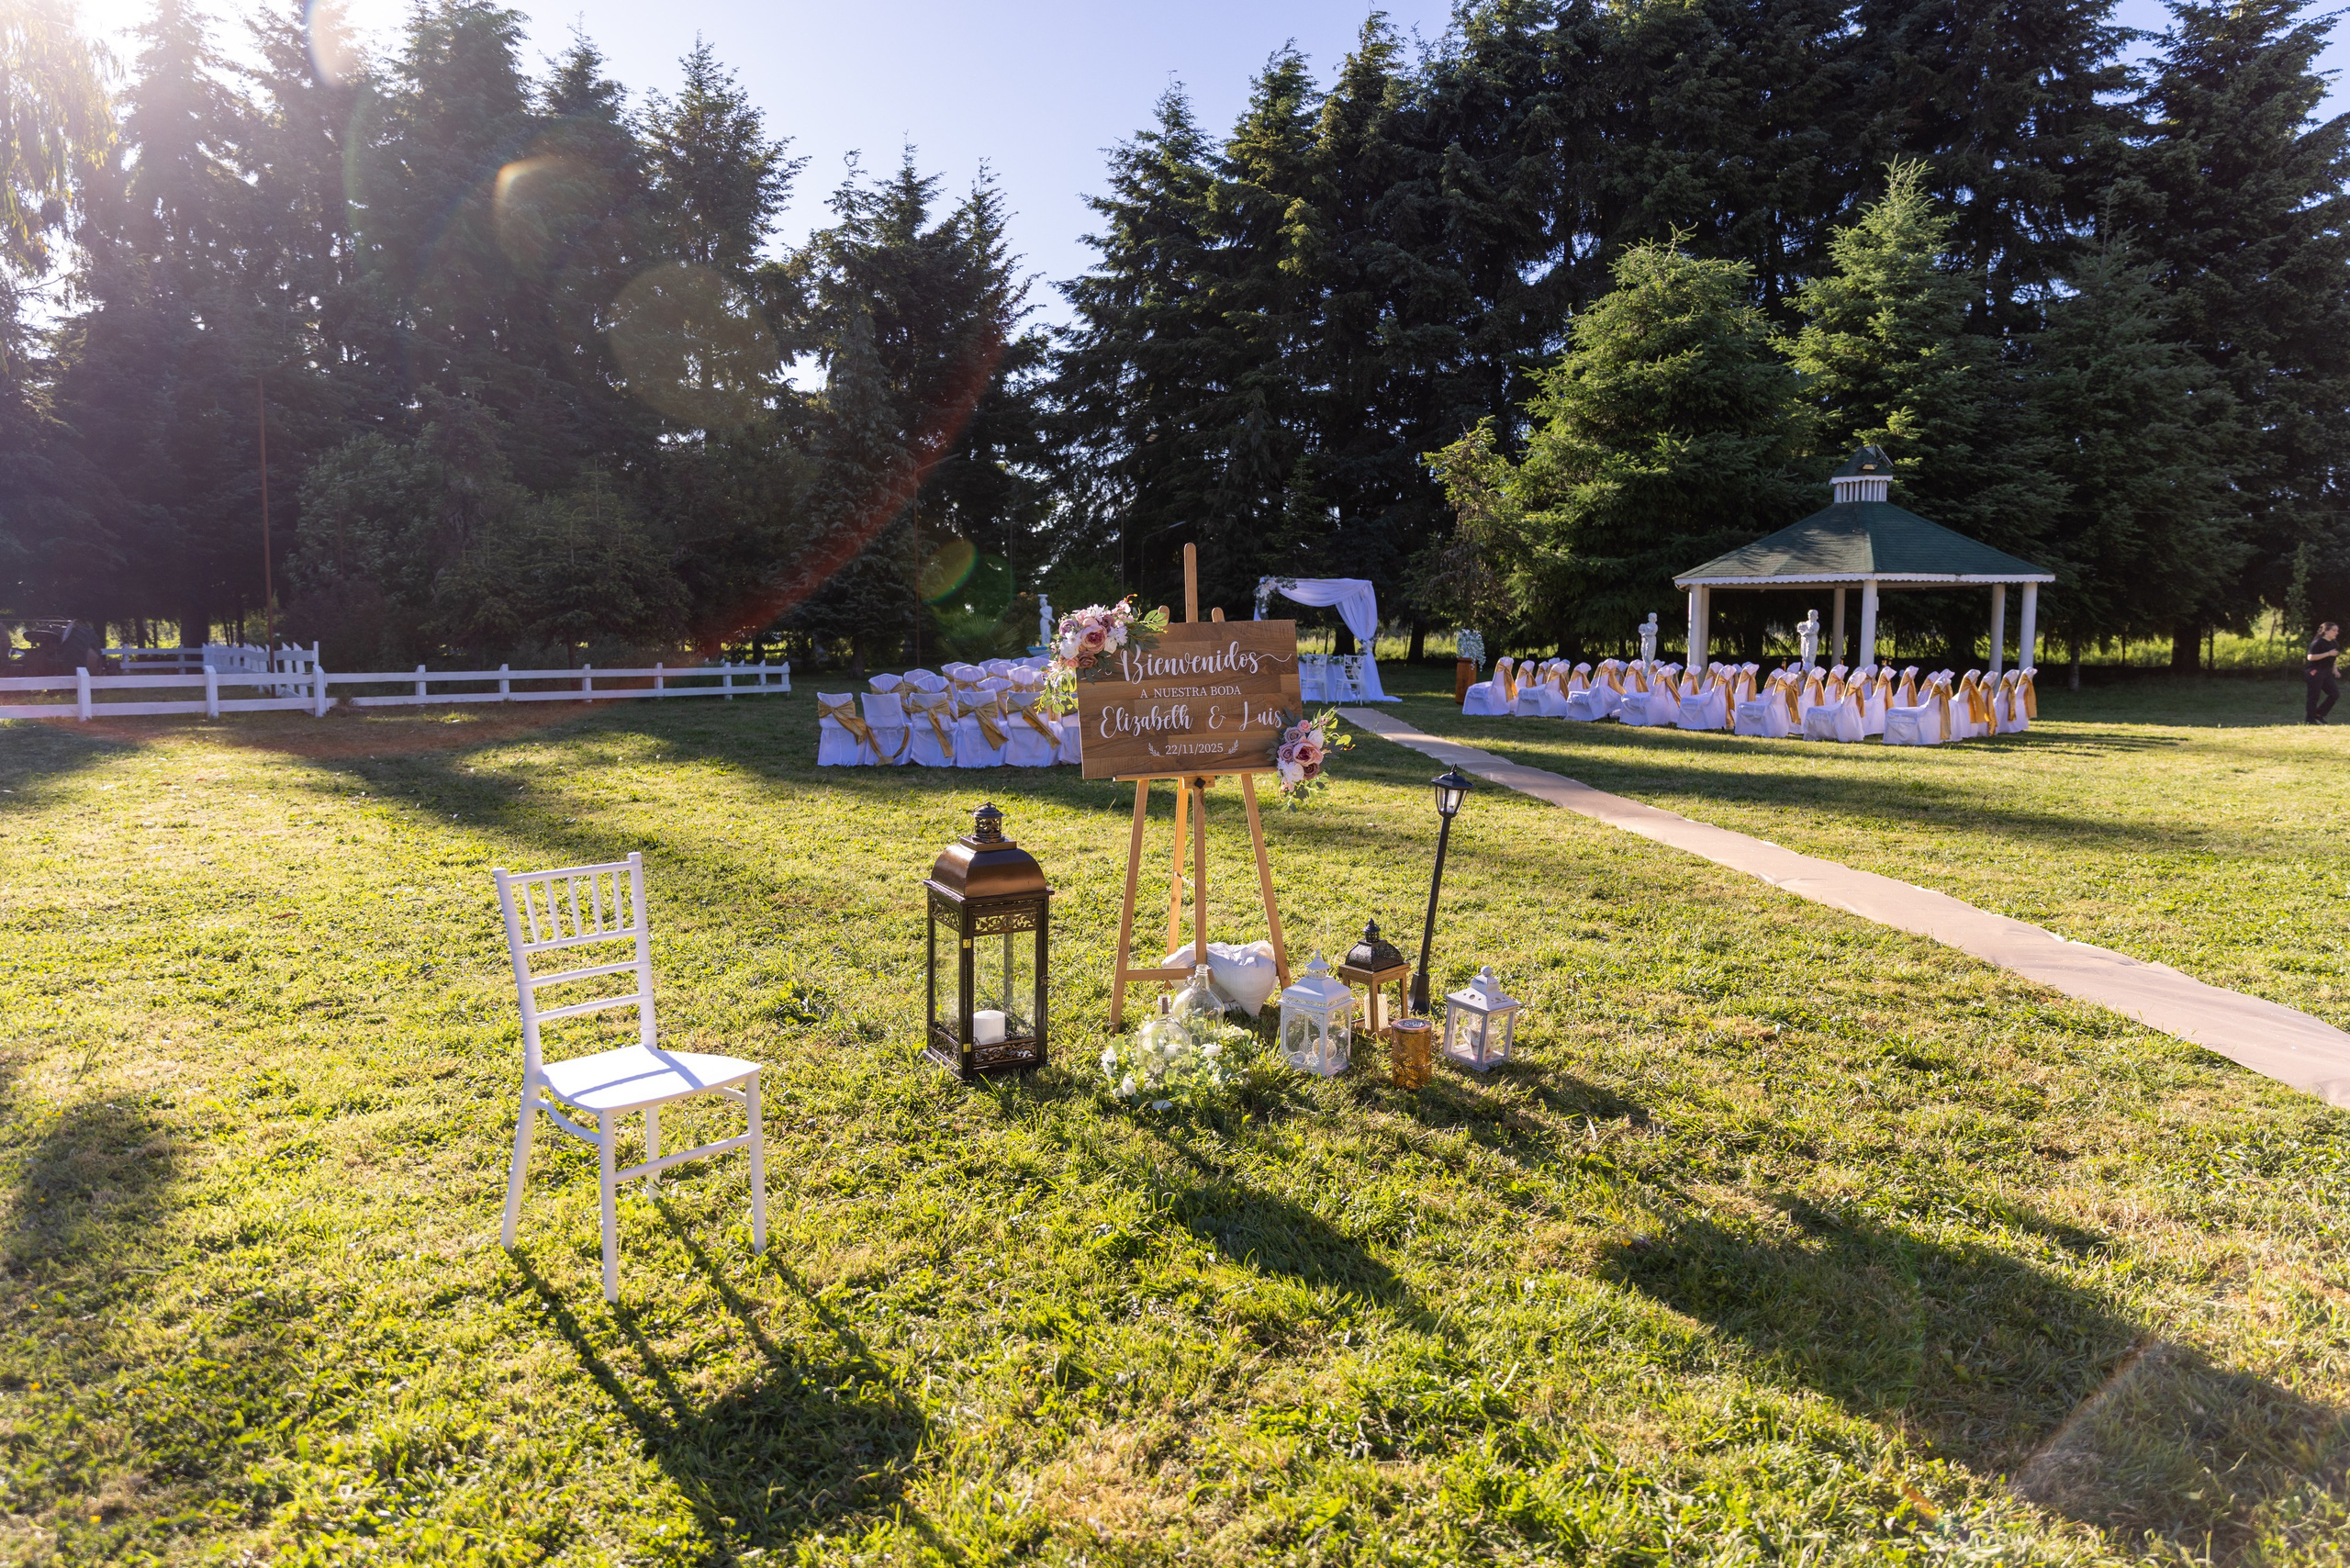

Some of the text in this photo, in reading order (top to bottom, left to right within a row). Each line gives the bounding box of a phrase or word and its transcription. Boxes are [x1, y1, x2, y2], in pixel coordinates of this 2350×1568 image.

[1116, 641, 1292, 685] Bienvenidos
[1140, 685, 1241, 699] A NUESTRA BODA
[1100, 700, 1282, 739] Elizabeth & Luis
[1165, 743, 1225, 756] 22/11/2025
